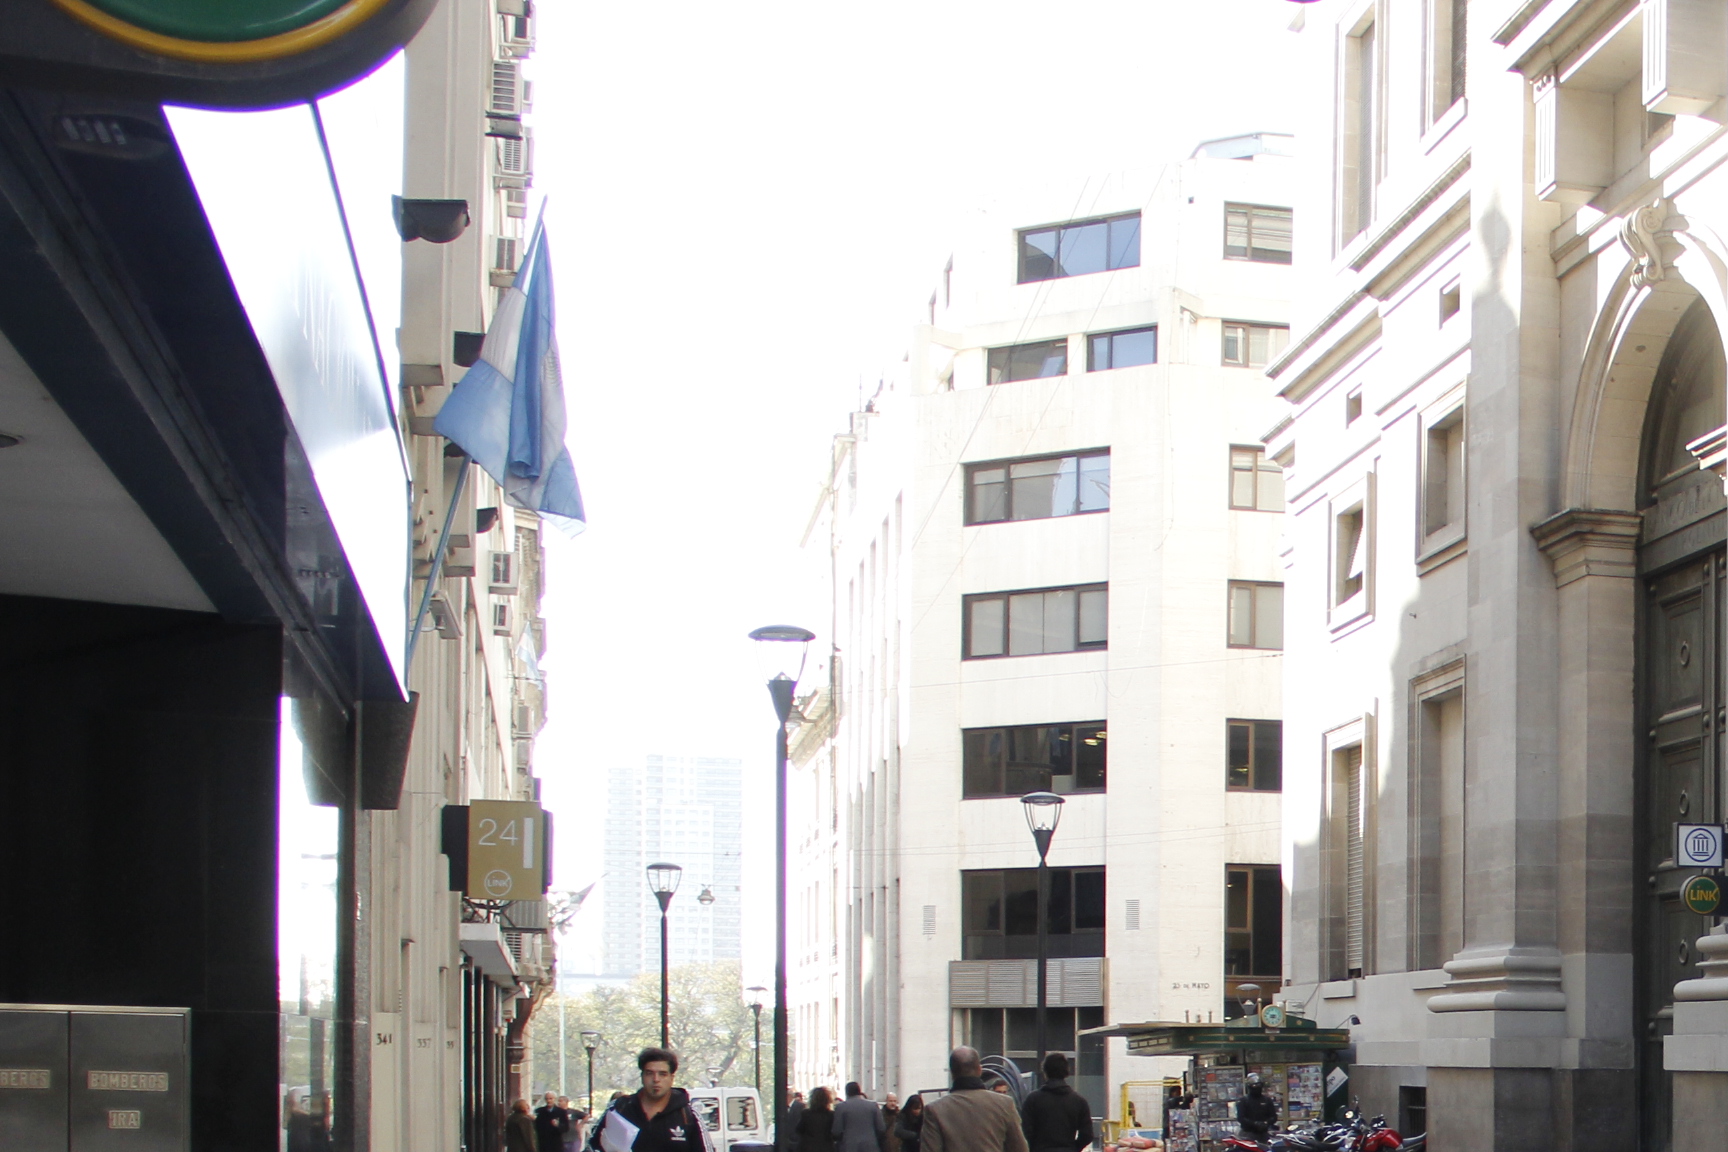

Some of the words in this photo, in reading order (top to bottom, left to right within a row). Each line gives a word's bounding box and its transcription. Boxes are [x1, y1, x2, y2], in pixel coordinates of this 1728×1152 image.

[478, 818, 519, 847] 24
[486, 876, 511, 887] LINK
[1690, 886, 1719, 902] LINK
[376, 1033, 393, 1046] 341
[90, 1073, 166, 1089] BOMBEROS
